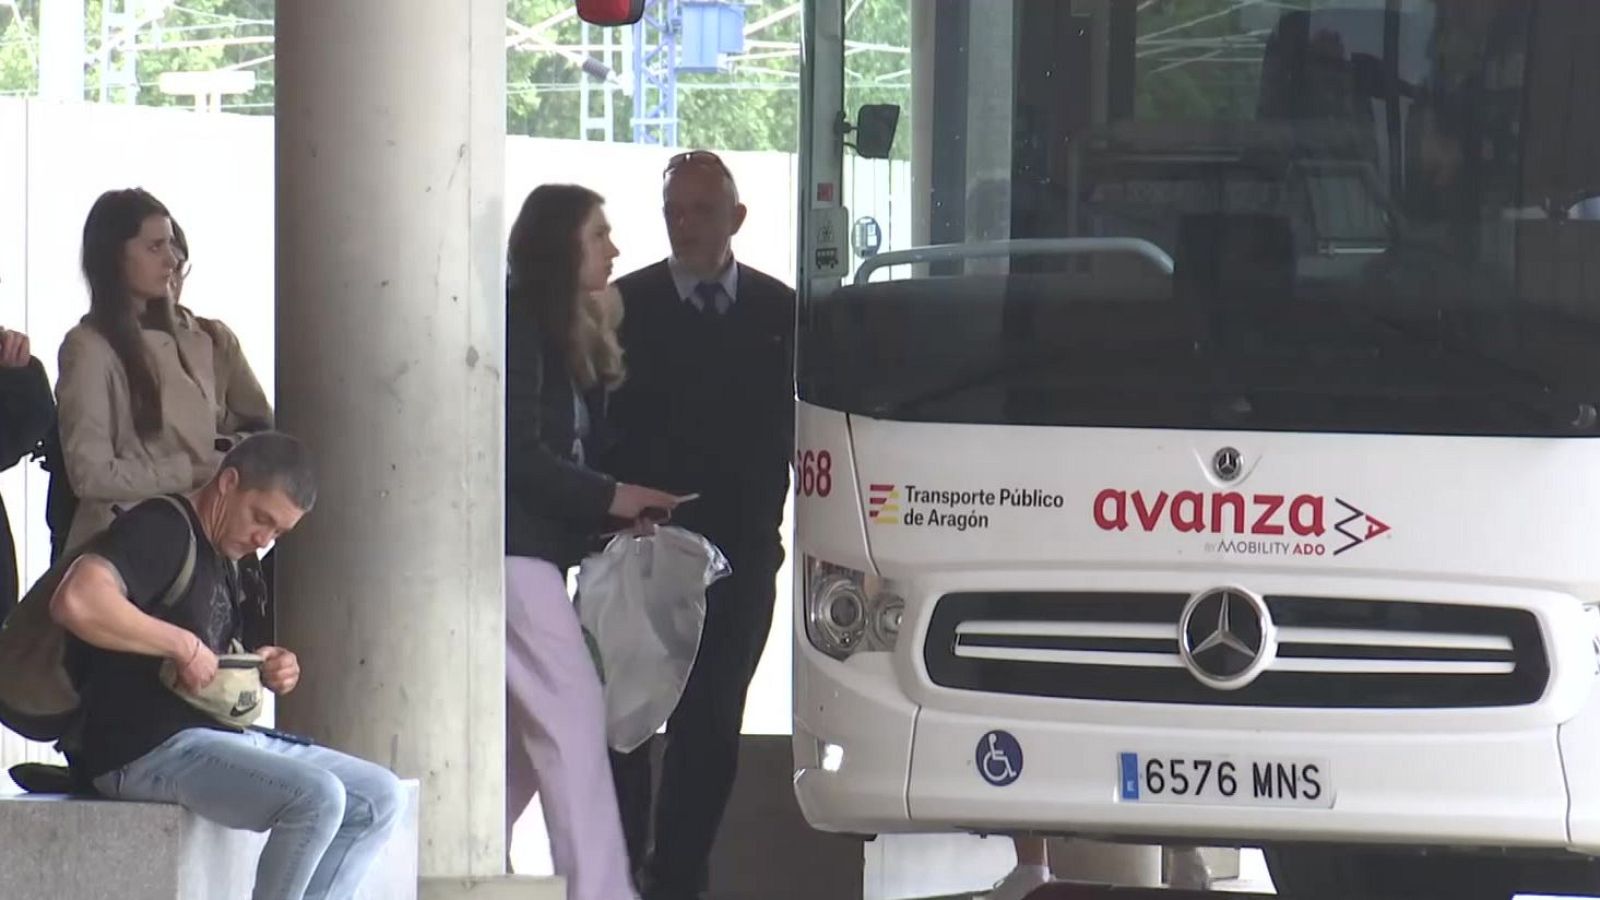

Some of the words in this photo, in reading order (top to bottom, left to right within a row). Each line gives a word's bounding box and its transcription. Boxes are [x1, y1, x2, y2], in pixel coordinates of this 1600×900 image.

[904, 485, 995, 506] Transporte
[1000, 487, 1064, 508] Público
[904, 509, 924, 526] de
[928, 509, 988, 531] Aragón
[1093, 488, 1326, 537] avanza
[1217, 540, 1290, 555] MOBILITY
[1292, 543, 1326, 556] ADO
[1145, 758, 1237, 797] 6576
[1252, 761, 1321, 800] MNS
